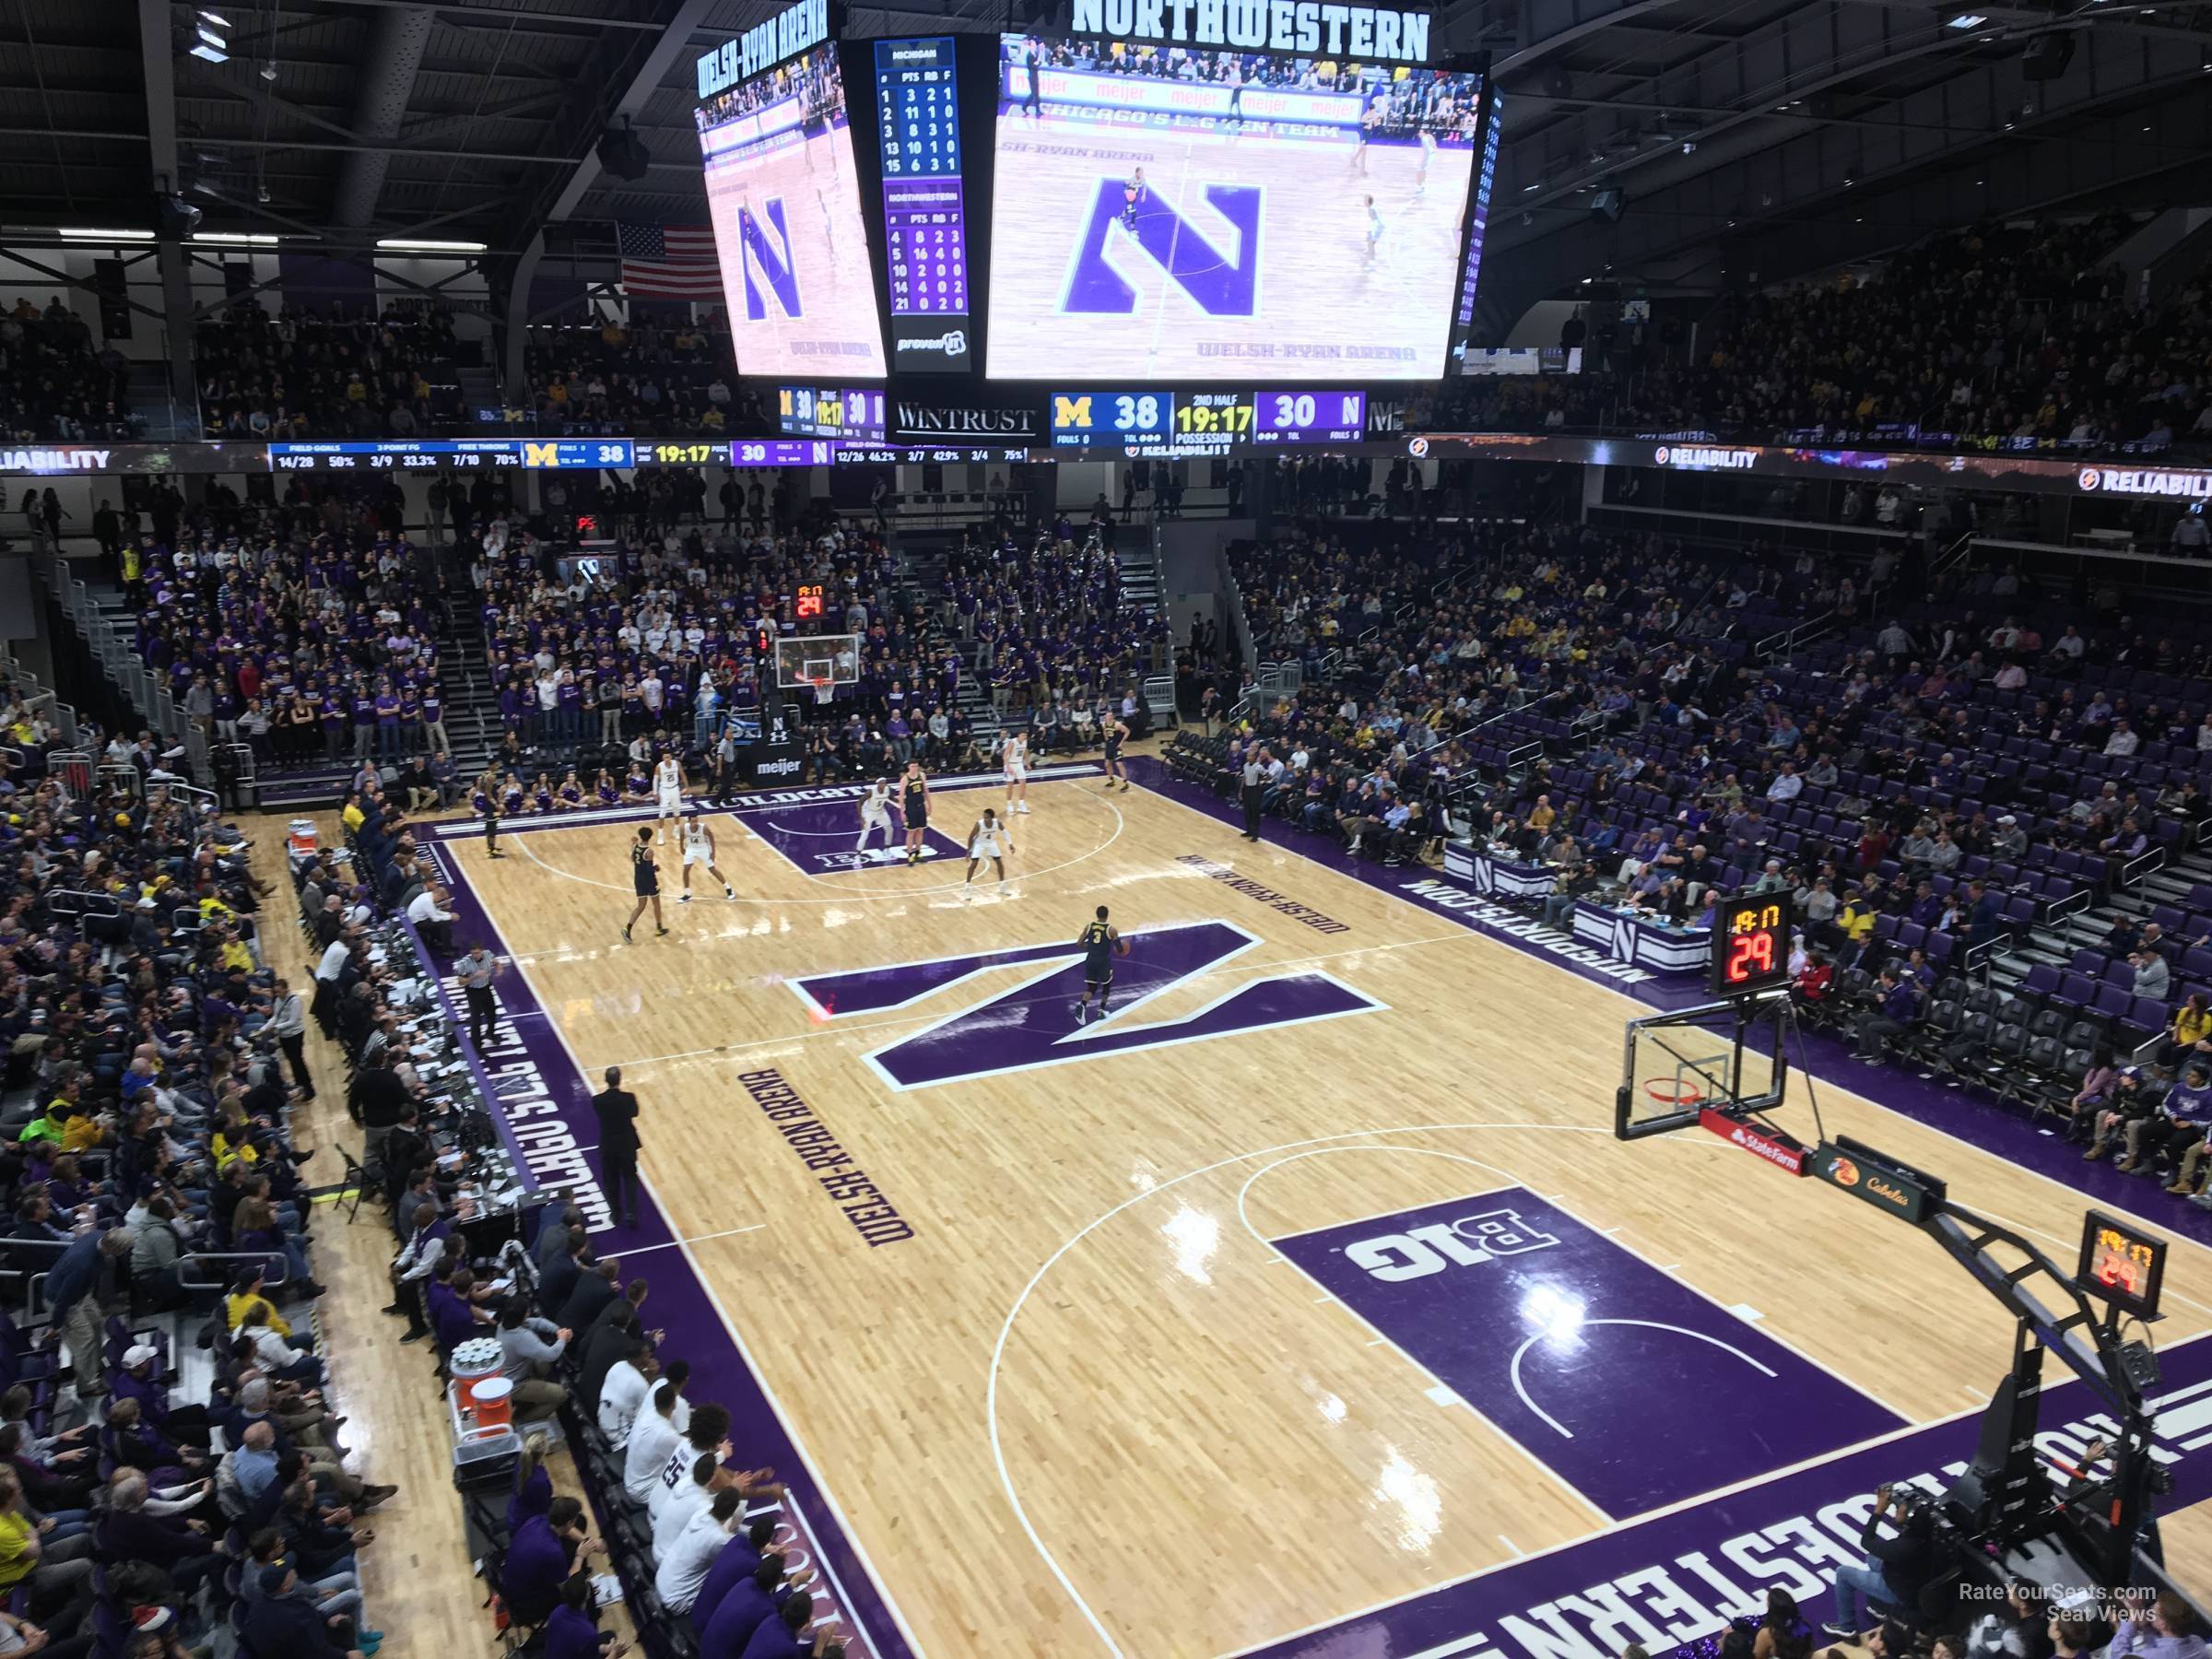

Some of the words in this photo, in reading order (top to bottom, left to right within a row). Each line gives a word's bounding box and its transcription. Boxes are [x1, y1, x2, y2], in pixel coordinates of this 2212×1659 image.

[1072, 0, 1430, 61] NORTHWESTERN
[697, 17, 777, 99] WELSH-RYAN
[778, 0, 828, 61] ARENA
[892, 49, 936, 60] MICHIGAN
[902, 72, 920, 82] PTS
[924, 71, 938, 81] RB
[944, 70, 951, 80] F
[882, 89, 889, 102] 1
[907, 88, 915, 101] 3
[927, 88, 935, 100] 2
[944, 87, 951, 100] 1
[1096, 79, 1147, 102] meijer
[1171, 85, 1218, 108] meijer
[1245, 91, 1289, 115] meijer
[1311, 99, 1356, 121] meijer
[883, 107, 892, 121] 2
[905, 106, 919, 120] 11
[928, 105, 935, 119] 1
[945, 104, 953, 118] 0
[884, 124, 892, 138] 3
[909, 124, 918, 136] 8
[929, 124, 937, 136] 3
[946, 123, 953, 135] 1
[885, 142, 900, 155] 13
[907, 141, 922, 154] 10
[930, 140, 937, 154] 1
[947, 140, 955, 153] 0
[886, 159, 900, 172] 15
[912, 159, 920, 171] 6
[931, 158, 939, 171] 3
[947, 158, 955, 171] 1
[888, 192, 958, 203] NORTHWESTERN
[911, 214, 928, 224] PTS
[951, 214, 959, 223] F
[891, 230, 900, 243] 4
[915, 230, 924, 243] 8
[935, 230, 944, 243] 2
[951, 229, 959, 243] 3
[892, 248, 901, 261] 5
[913, 247, 928, 260] 16
[935, 247, 945, 260] 4
[952, 247, 961, 260] 0
[893, 265, 908, 276] 10
[917, 264, 926, 276] 2
[936, 264, 946, 276] 0
[953, 264, 962, 276] 0
[894, 281, 908, 293] 14
[918, 281, 928, 293] 4
[937, 280, 947, 293] 0
[954, 280, 962, 293] 2
[895, 298, 909, 310] 21
[919, 298, 929, 310] 0
[938, 298, 947, 310] 2
[955, 297, 963, 310] 0
[1197, 342, 1343, 359] WELSH-RYAN
[1346, 345, 1417, 360] ARENA
[849, 393, 865, 424] 30
[1193, 394, 1213, 406] 2ND
[1214, 394, 1238, 406] HALF
[897, 402, 1037, 431] WINTRUST
[1054, 396, 1092, 428] M
[1114, 395, 1159, 429] 38
[1177, 406, 1253, 432] 19:17
[1274, 394, 1316, 428] 30
[1342, 396, 1359, 425] N
[1056, 435, 1079, 443] FOULS
[1083, 434, 1089, 443] 0
[1175, 432, 1232, 444] POSSESSION
[1330, 430, 1349, 440] FOULS
[1353, 430, 1359, 440] 0
[371, 455, 393, 467] 3/9
[403, 455, 437, 466] 33.3%
[453, 454, 480, 466] 7/10
[494, 454, 518, 465] 70%
[525, 443, 559, 466] M
[598, 445, 624, 463] 38
[655, 445, 711, 463] 19:17
[741, 444, 766, 461] 30
[812, 442, 828, 464] N
[837, 452, 865, 463] 12/26
[907, 452, 925, 461] 3/7
[971, 451, 988, 461] 3/4
[1004, 450, 1023, 460] 75%
[1669, 448, 1758, 468] RELIABILITY
[277, 455, 314, 468] 14/28
[328, 455, 355, 467] 50%
[797, 595, 821, 616] 29
[773, 717, 783, 731] N
[758, 758, 802, 775] meijer
[1475, 856, 1493, 894] N
[1224, 877, 1352, 935] WELSH-RYAN
[1735, 905, 1780, 935] 19:17
[1093, 931, 1101, 943] 3
[1398, 877, 1660, 984] NUSPORTS.COM
[1611, 919, 1637, 964] N
[1730, 932, 1773, 980] 29
[736, 1067, 813, 1122] ARENA
[777, 1119, 915, 1248] WELSH-RYAN
[2100, 1230, 2153, 1268] 19:17
[2099, 1254, 2139, 1292] 29
[663, 1455, 686, 1489] 25
